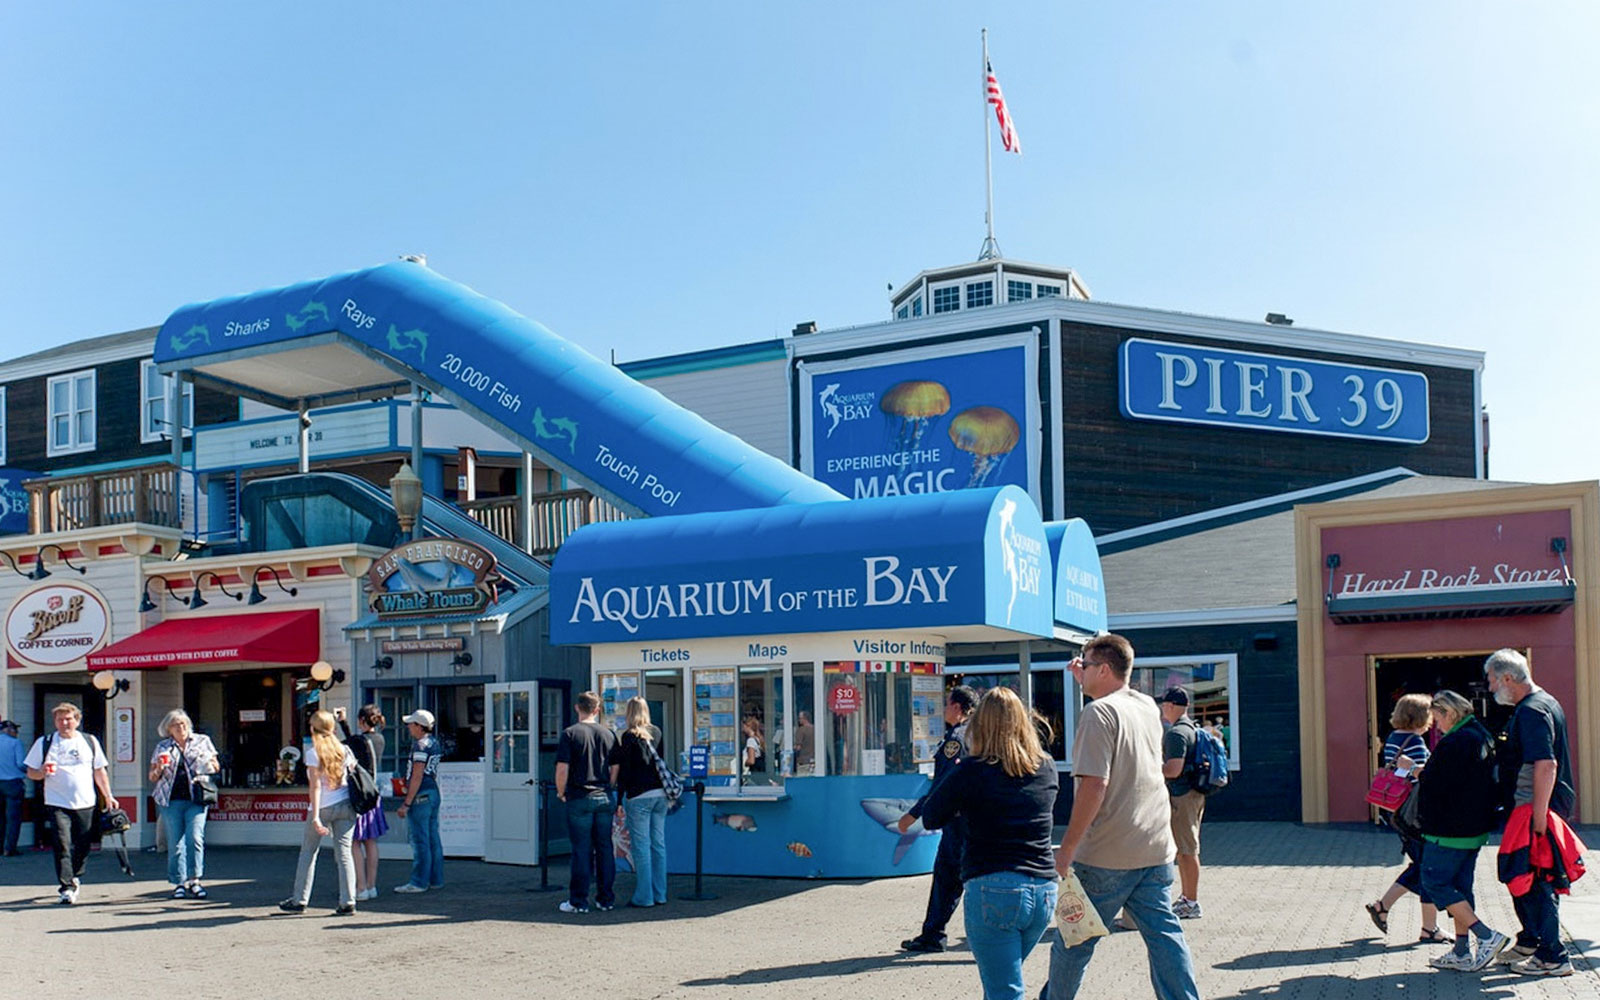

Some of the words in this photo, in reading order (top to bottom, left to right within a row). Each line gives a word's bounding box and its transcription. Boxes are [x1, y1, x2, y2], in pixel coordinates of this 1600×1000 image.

[341, 299, 376, 330] Rays
[224, 316, 270, 337] Sharks
[440, 353, 490, 392] 20,000
[489, 382, 522, 413] Fish
[1156, 352, 1321, 423] PIER
[1340, 374, 1404, 430] 39
[831, 392, 875, 405] AQUARIUM
[843, 404, 873, 421] BAY
[250, 436, 278, 449] WELCOME
[284, 435, 293, 445] TO
[827, 452, 909, 473] EXPERIENCE
[913, 449, 940, 464] THE
[594, 445, 639, 485] Touch
[640, 474, 682, 508] Pool
[854, 468, 956, 500] MAGIC
[376, 553, 400, 578] SAN
[406, 543, 484, 570] FRANCISCO
[1019, 557, 1041, 597] BAY
[1065, 564, 1099, 592] AQUARIUM
[1342, 570, 1412, 595] Hard
[1418, 566, 1480, 590] Rock
[1488, 563, 1561, 585] Store
[381, 592, 427, 612] Whale
[430, 591, 474, 608] Tours
[568, 576, 773, 634] AQUARIUM
[778, 591, 807, 612] OF
[812, 588, 858, 609] THE
[862, 555, 958, 607] BAY
[1065, 588, 1099, 616] ENTRANCE
[18, 639, 53, 650] COFFEE
[55, 637, 93, 648] CORNER
[748, 643, 788, 659] Maps
[853, 639, 906, 654] Visitor
[129, 654, 151, 663] COOKIE
[152, 652, 176, 662] SERVED
[177, 651, 193, 660] WITH
[193, 650, 213, 659] EVERY
[214, 648, 239, 658] COFFEE
[640, 647, 690, 663] Tickets
[836, 688, 854, 698] $10
[250, 812, 264, 820] CUP
[265, 811, 275, 820] OF
